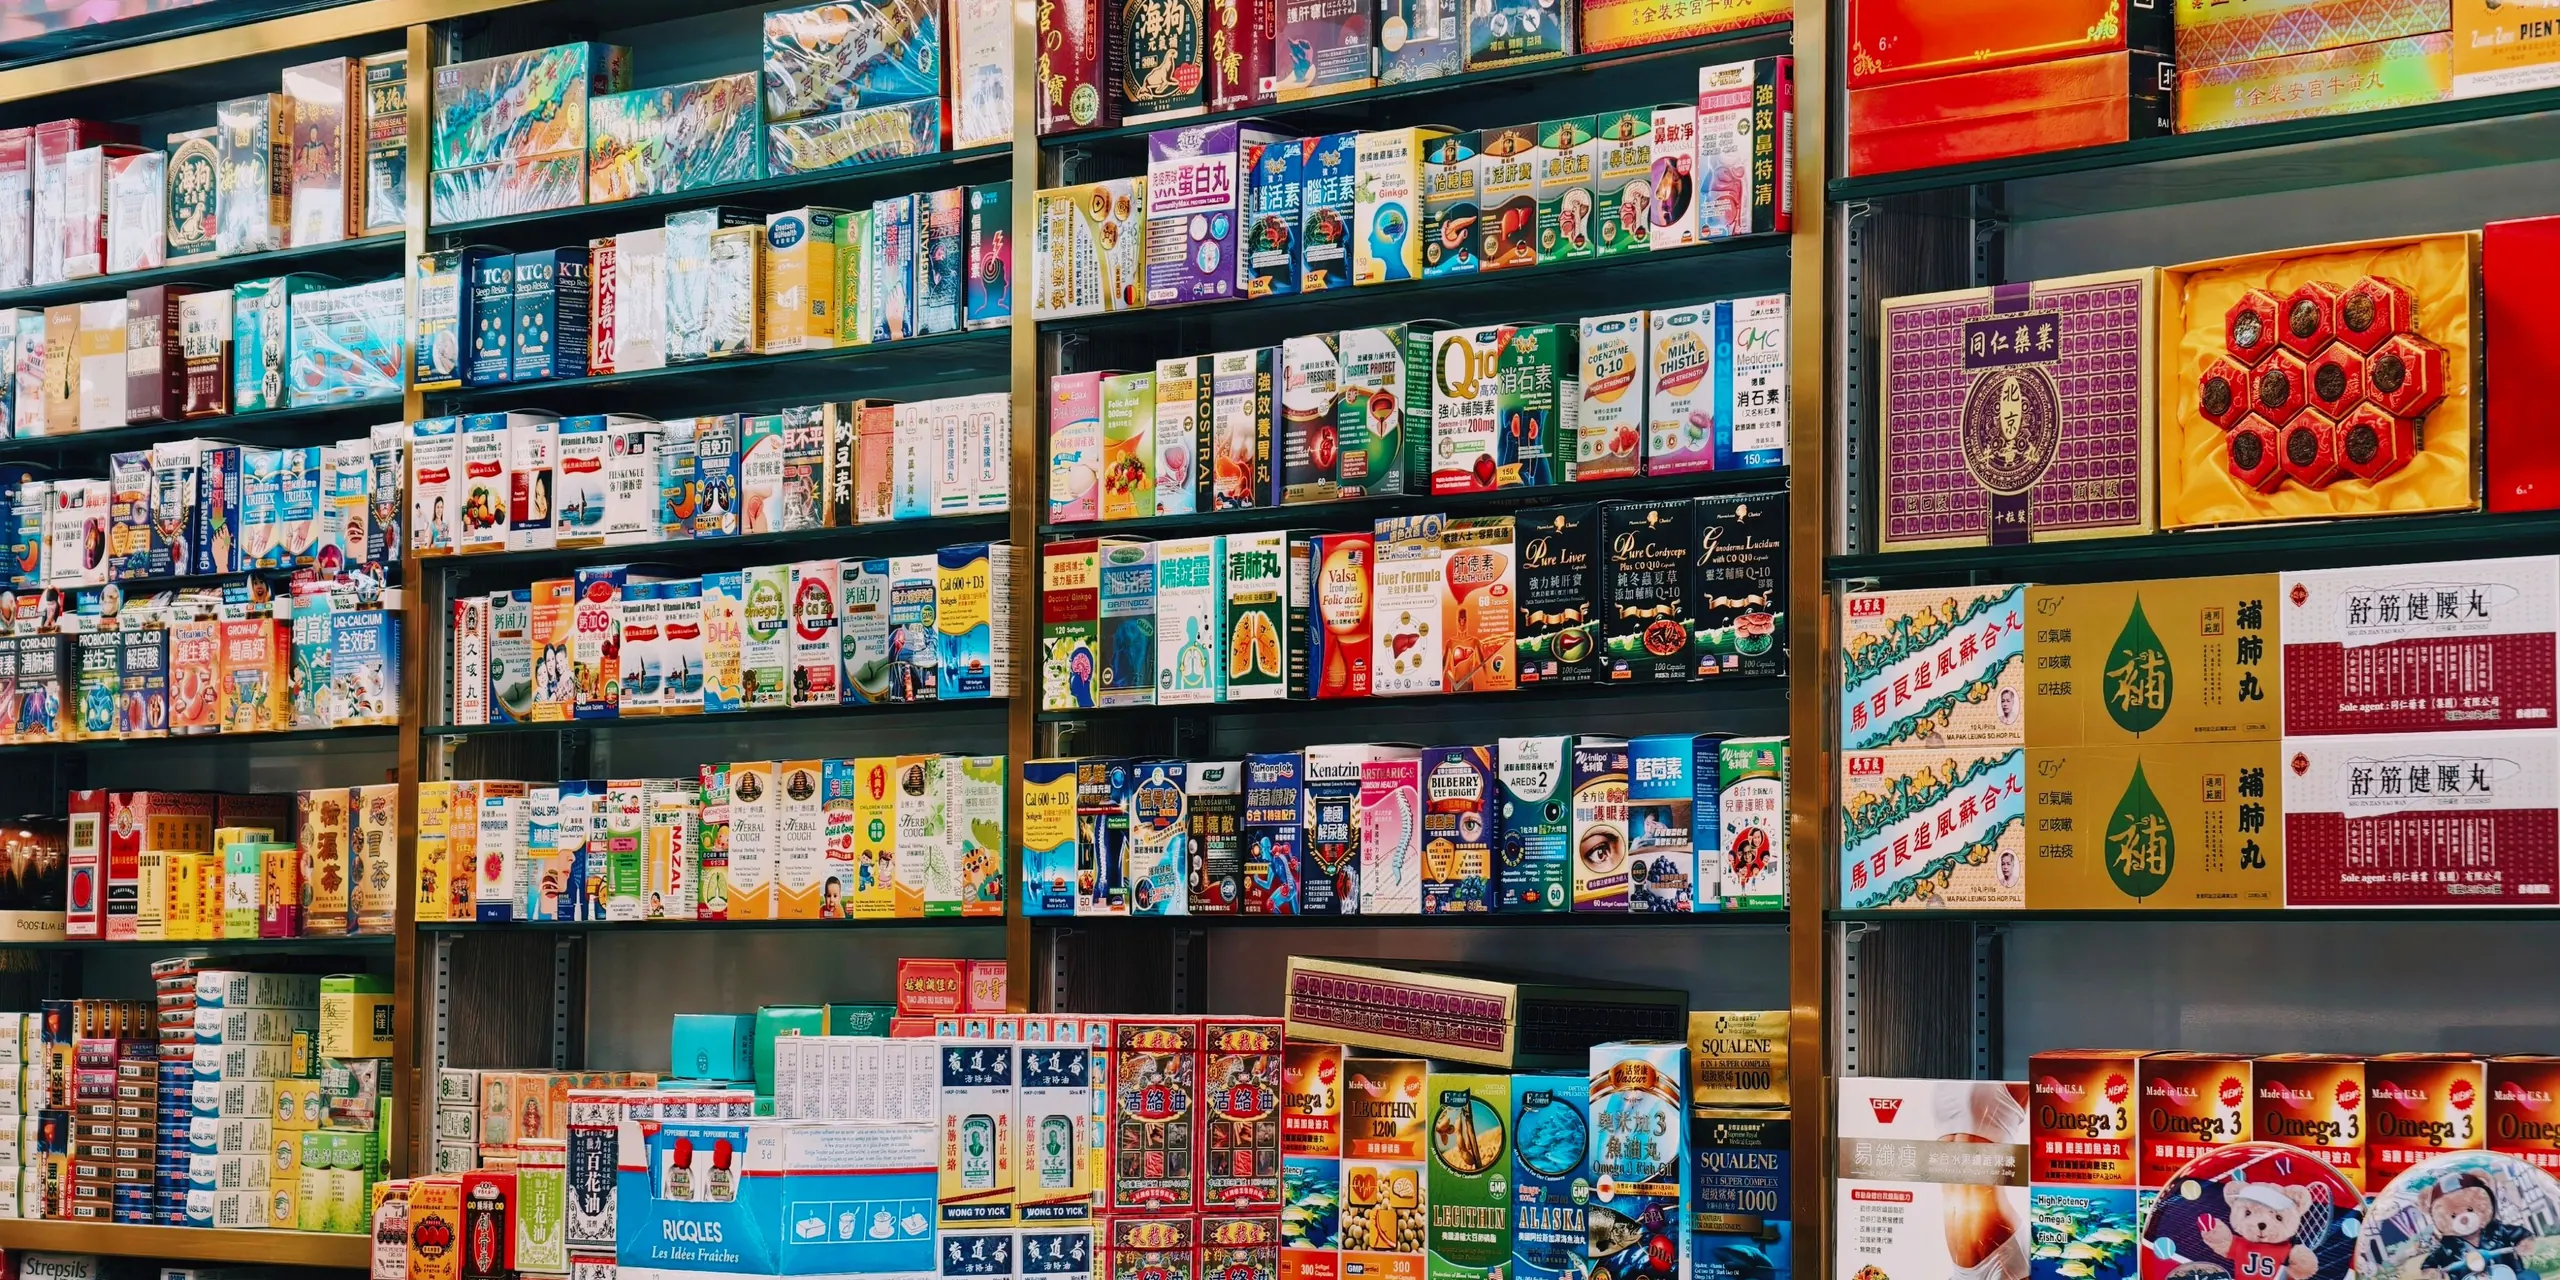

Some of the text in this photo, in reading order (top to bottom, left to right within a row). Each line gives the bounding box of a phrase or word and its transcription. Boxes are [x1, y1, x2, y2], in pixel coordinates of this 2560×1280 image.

[1755, 84, 1773, 206] 強效鼻特清
[1382, 178, 1406, 188] Strength
[1386, 173, 1401, 181] Extra
[1379, 187, 1409, 199] Ginkgo
[516, 282, 549, 293] Sleep Relax
[1668, 339, 1696, 358] MILK
[1970, 322, 2054, 358] 同仁藥業
[1588, 344, 1629, 364] COENZYME
[1660, 351, 1705, 374] THISTLE
[1737, 352, 1780, 365] Medicrew
[1596, 358, 1623, 377] Q-10
[1500, 364, 1552, 395] 消石素
[1737, 389, 1780, 408] 消石素
[2002, 384, 2020, 433] 北京
[1200, 373, 1212, 494] PROSTRAL
[1468, 418, 1495, 434] 200mg
[1743, 454, 1761, 465] 150
[1523, 536, 1587, 569] Pure Liver
[1612, 531, 1687, 561] Pure Cordyceps
[1696, 525, 1780, 567] Ganoderma Lucidum
[1229, 548, 1281, 582] 清肺丸
[1454, 554, 1494, 573] 肝德素
[1746, 566, 1771, 580] Q-10
[973, 578, 984, 590] D3
[1328, 568, 1357, 584] Valsa
[1401, 569, 1441, 583] Formula
[1329, 582, 1344, 593] Iron
[1656, 586, 1680, 599] Q-10
[623, 602, 656, 614] Vitamin Plus
[1322, 593, 1363, 606] Folic acid
[2350, 589, 2488, 625] 舒筋健腰丸
[125, 631, 160, 644] URIC ACID
[708, 622, 741, 643] DHA
[2048, 628, 2072, 643] 氣喘
[2236, 600, 2264, 702] 補肺丸
[466, 642, 478, 699] 久咳丸
[2048, 655, 2072, 669] 咳嗽
[2048, 682, 2072, 696] 祛痰
[2107, 649, 2165, 712] 補
[2339, 703, 2357, 712] Sole
[1309, 761, 1360, 779] Kenatzin
[1635, 757, 1683, 781] 藍莓素
[1432, 775, 1480, 789] BILBERRY
[1510, 771, 1548, 789] AREDS 2
[2352, 762, 2490, 796] 舒筋健腰丸
[1057, 790, 1069, 805] D3
[1433, 786, 1477, 798] EYE BRIGHT
[2050, 791, 2073, 806] 氣喘
[732, 819, 766, 833] HERBAL
[2050, 818, 2073, 832] 咳嗽
[2238, 767, 2266, 870] 補肺丸
[736, 832, 760, 843] COUGH
[1317, 822, 1349, 841] 解尿酸
[2050, 845, 2073, 859] 祛痰
[2108, 814, 2167, 877] 補
[671, 826, 682, 896] NAZAL
[1701, 1038, 1772, 1057] SQUALENE
[1735, 1071, 1770, 1090] 1000
[2035, 1084, 2054, 1094] Made
[2056, 1084, 2063, 1094] in
[1124, 1090, 1187, 1112] 活絡油
[1212, 1089, 1275, 1111] 活絡油
[1873, 1099, 1898, 1110] GEK
[1352, 1100, 1417, 1120] LECITHIN
[1373, 1121, 1397, 1138] 1200
[1653, 1112, 1667, 1137] 3
[2039, 1106, 2128, 1137] Omega 3
[2150, 1109, 2242, 1142] Omega 3
[2265, 1112, 2359, 1145] Omega 3
[1701, 1152, 1778, 1172] SQUALENE
[1854, 1142, 1917, 1168] 易纖瘦
[1592, 1162, 1624, 1176] Omega
[585, 1151, 601, 1214] 百花油
[1489, 1182, 1506, 1193] GMP
[1720, 1176, 1779, 1188] SUPER COMPLEX
[1737, 1190, 1777, 1212] 1000
[2038, 1195, 2089, 1209] High Potency
[533, 1191, 546, 1242] 百花油
[947, 1207, 1006, 1218] WONG TO YICK
[1433, 1205, 1506, 1230] LECITHIN
[1519, 1206, 1585, 1232] ALASKA
[2038, 1215, 2064, 1226] Omega
[662, 1219, 723, 1243] RICQLES
[652, 1247, 739, 1263] Les Idées Fraîches
[2241, 1252, 2276, 1277] JS
[26, 1255, 89, 1280] Strepsils
[1392, 1261, 1410, 1273] 300
